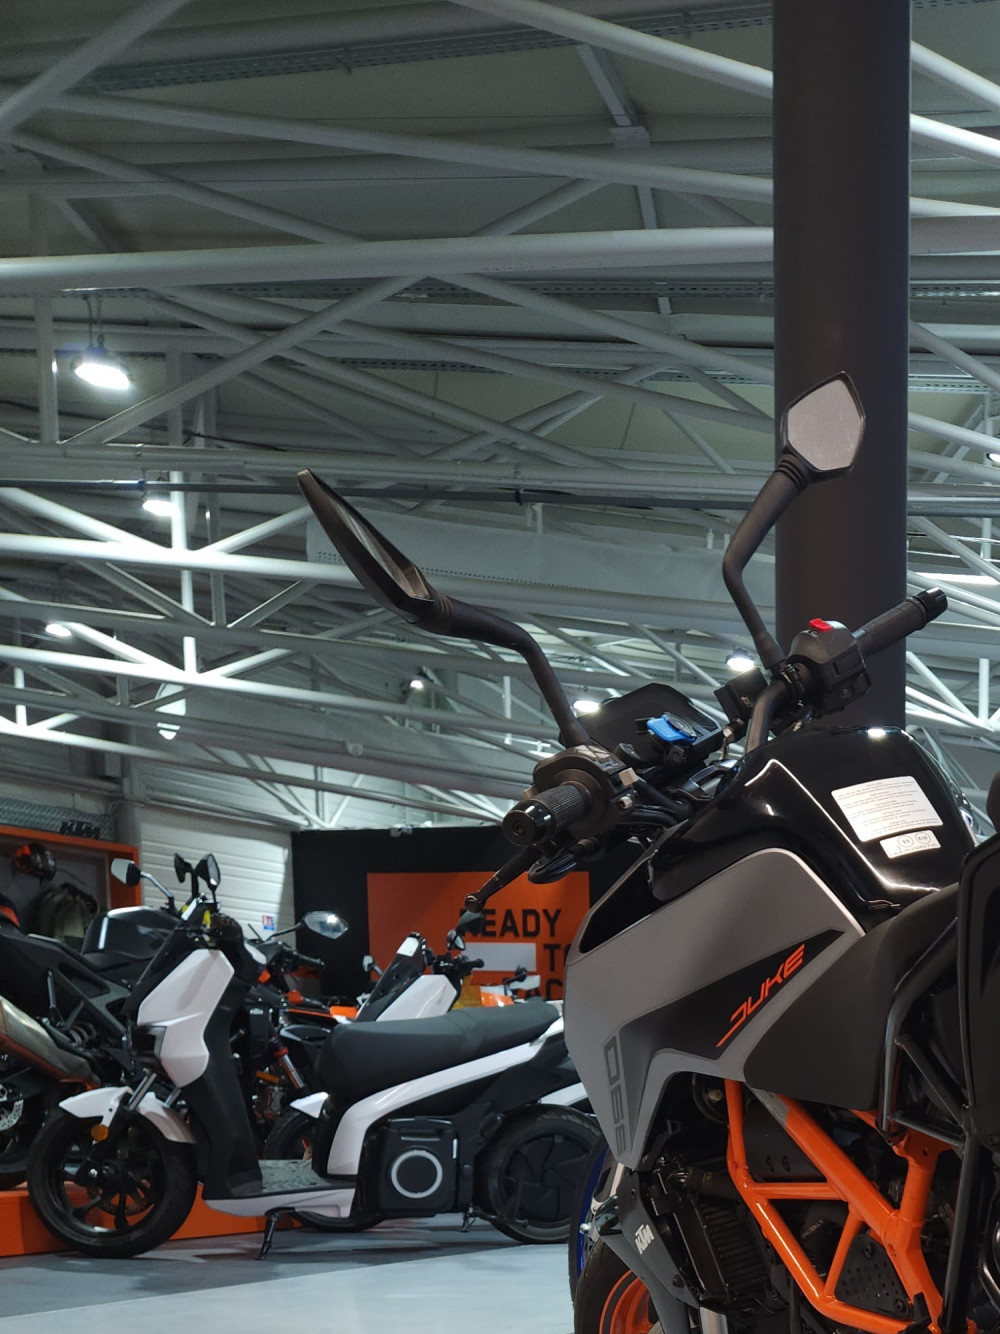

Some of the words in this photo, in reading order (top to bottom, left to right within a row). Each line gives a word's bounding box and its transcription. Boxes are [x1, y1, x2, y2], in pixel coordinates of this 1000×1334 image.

[715, 943, 805, 1048] DUKE
[603, 1034, 627, 1158] 390
[634, 1223, 655, 1255] KTM
